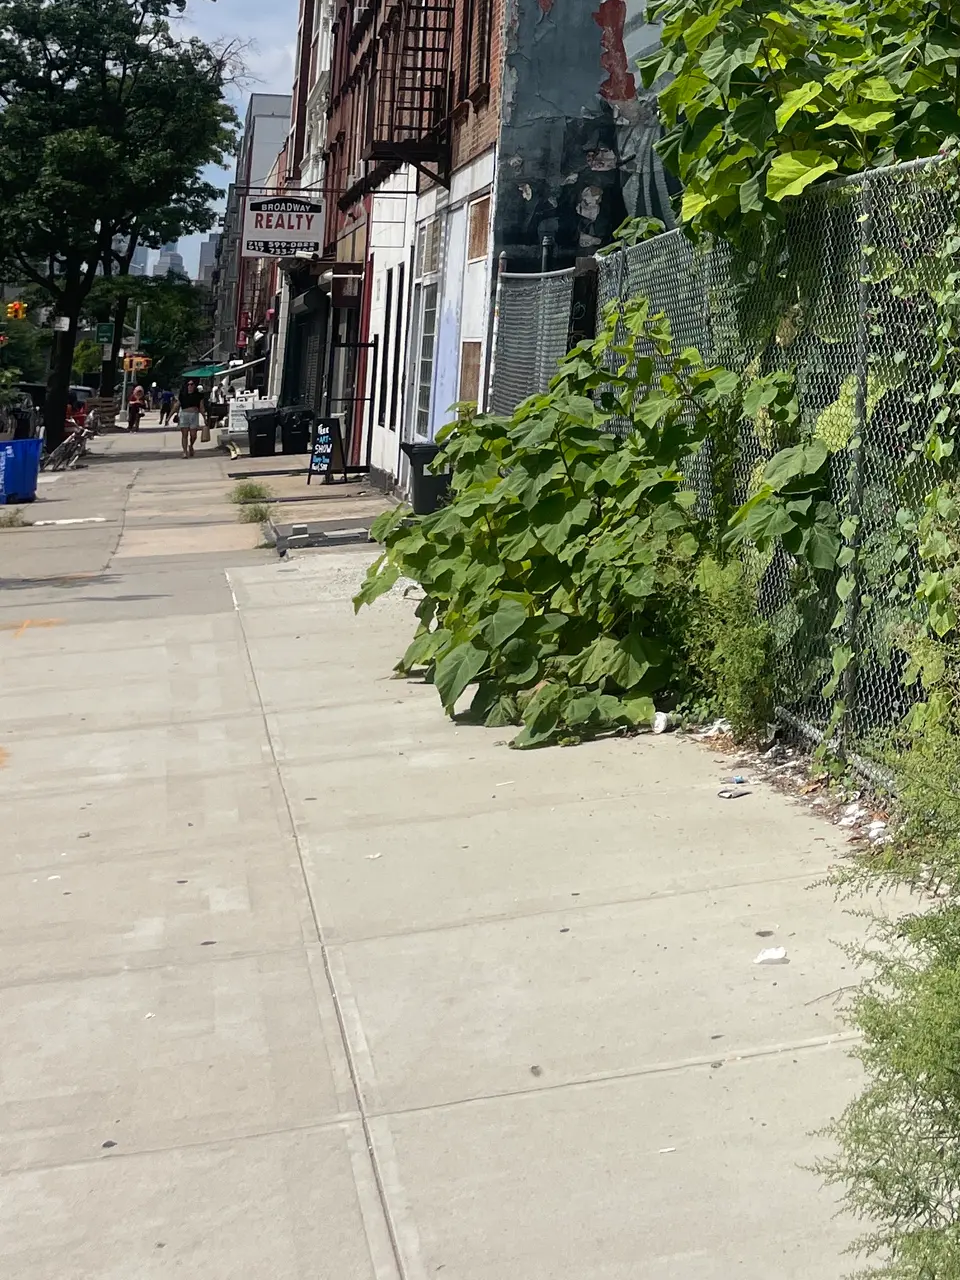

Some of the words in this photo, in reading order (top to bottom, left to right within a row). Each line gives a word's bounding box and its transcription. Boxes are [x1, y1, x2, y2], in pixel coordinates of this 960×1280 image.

[262, 203, 310, 211] BROADWAY
[254, 213, 314, 230] REALTY
[314, 444, 332, 454] SHOW
